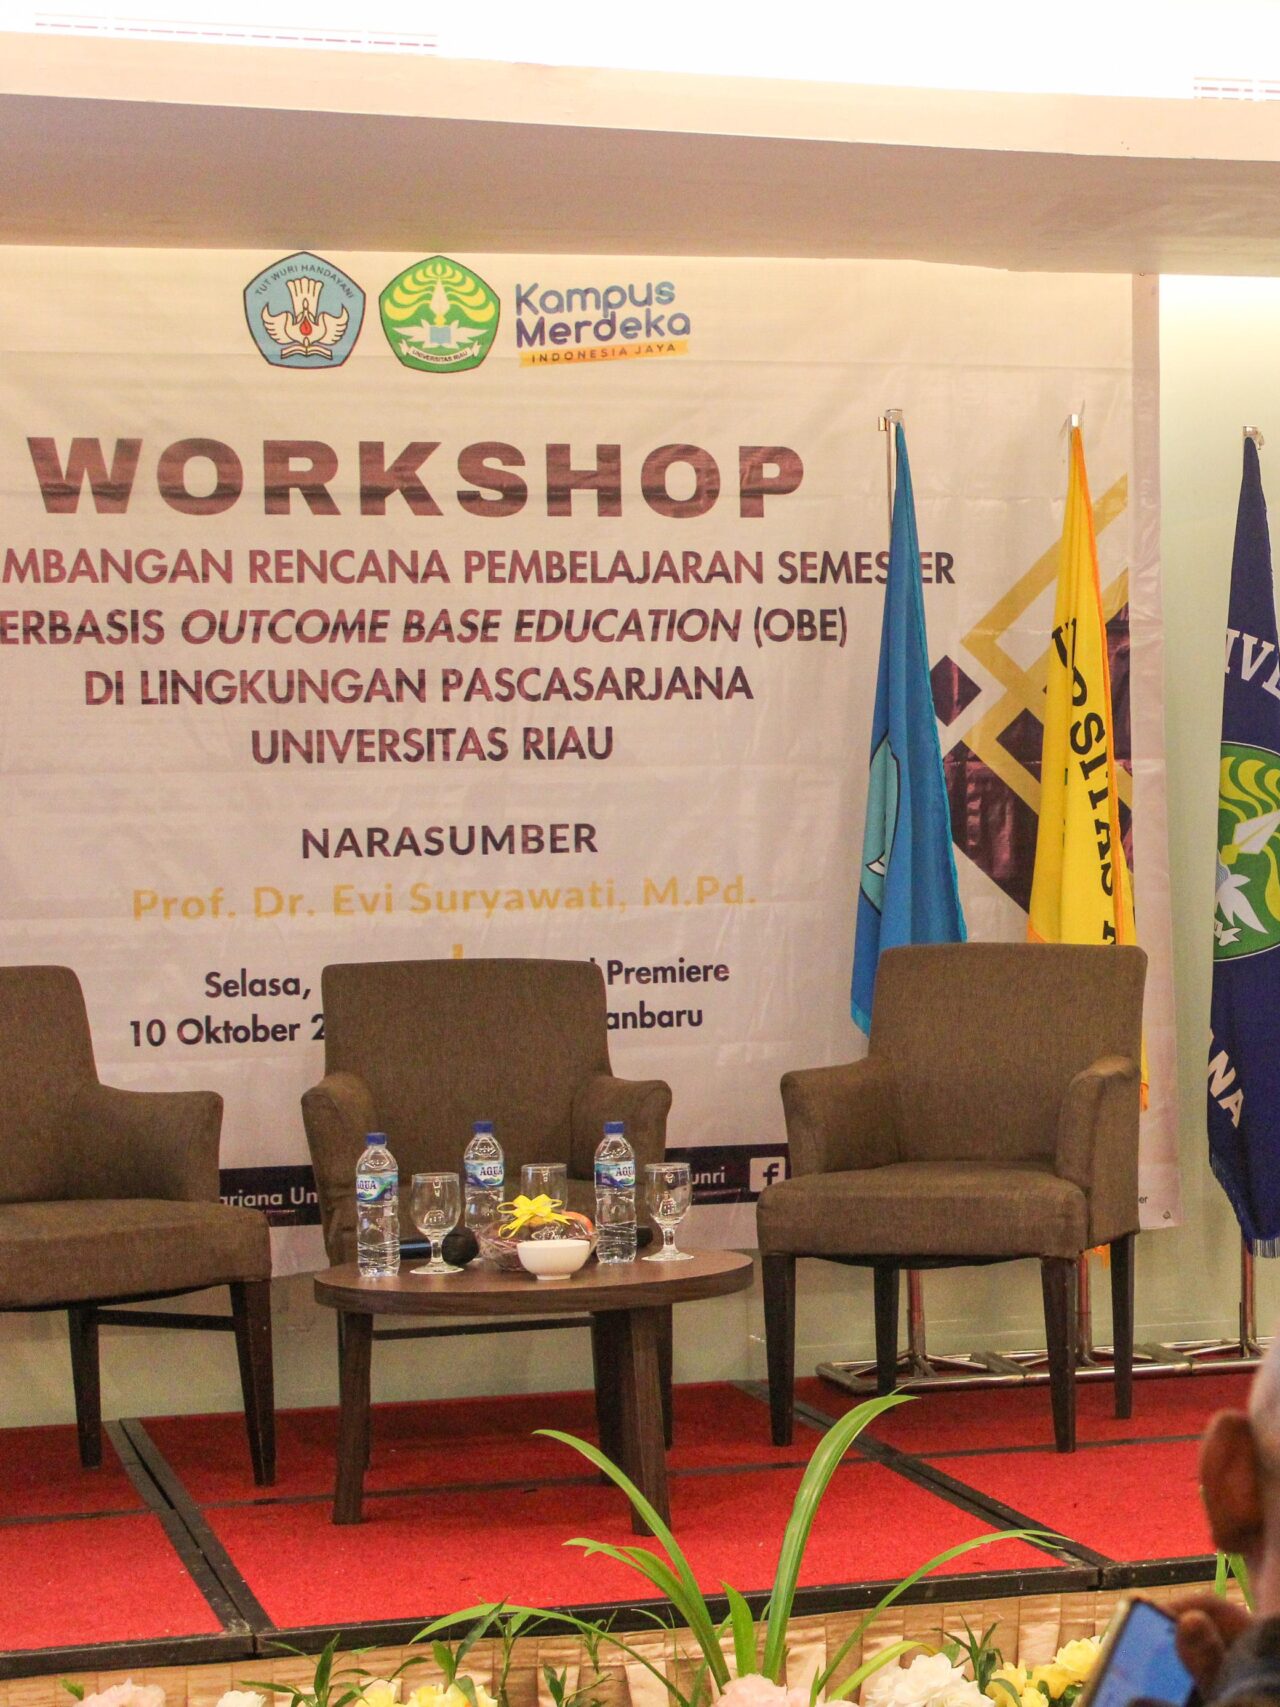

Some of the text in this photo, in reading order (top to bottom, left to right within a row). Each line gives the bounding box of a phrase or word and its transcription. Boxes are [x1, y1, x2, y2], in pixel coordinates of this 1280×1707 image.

[255, 264, 354, 299] TUT WURI HANDAYANI
[515, 281, 676, 318] Kampus
[516, 308, 691, 348] Merdeka
[412, 350, 453, 362] UNIVERSITAS
[531, 343, 676, 363] INDONESIA JAYA
[27, 437, 804, 518] WORKSHOP
[2, 548, 956, 585] MBANGAN RENCANA PEMBELAJARAN SEMESER
[0, 606, 847, 649] ERBASIS OUTCOME BASE EDUCATION (OBE)
[85, 666, 754, 705] DI LINGKUNGAN PASCASARJANA
[251, 726, 613, 764] UNIVERSITAS RIAU
[302, 823, 598, 858] NARASUMBER
[132, 874, 756, 921] Prof. Dr. Evi Suryawati, M.Pd.
[204, 968, 311, 1000] Selasa,
[607, 957, 730, 985] Premiere
[130, 1018, 166, 1047] 10
[177, 1013, 300, 1045] Oktober
[480, 1166, 503, 1178] AQUA
